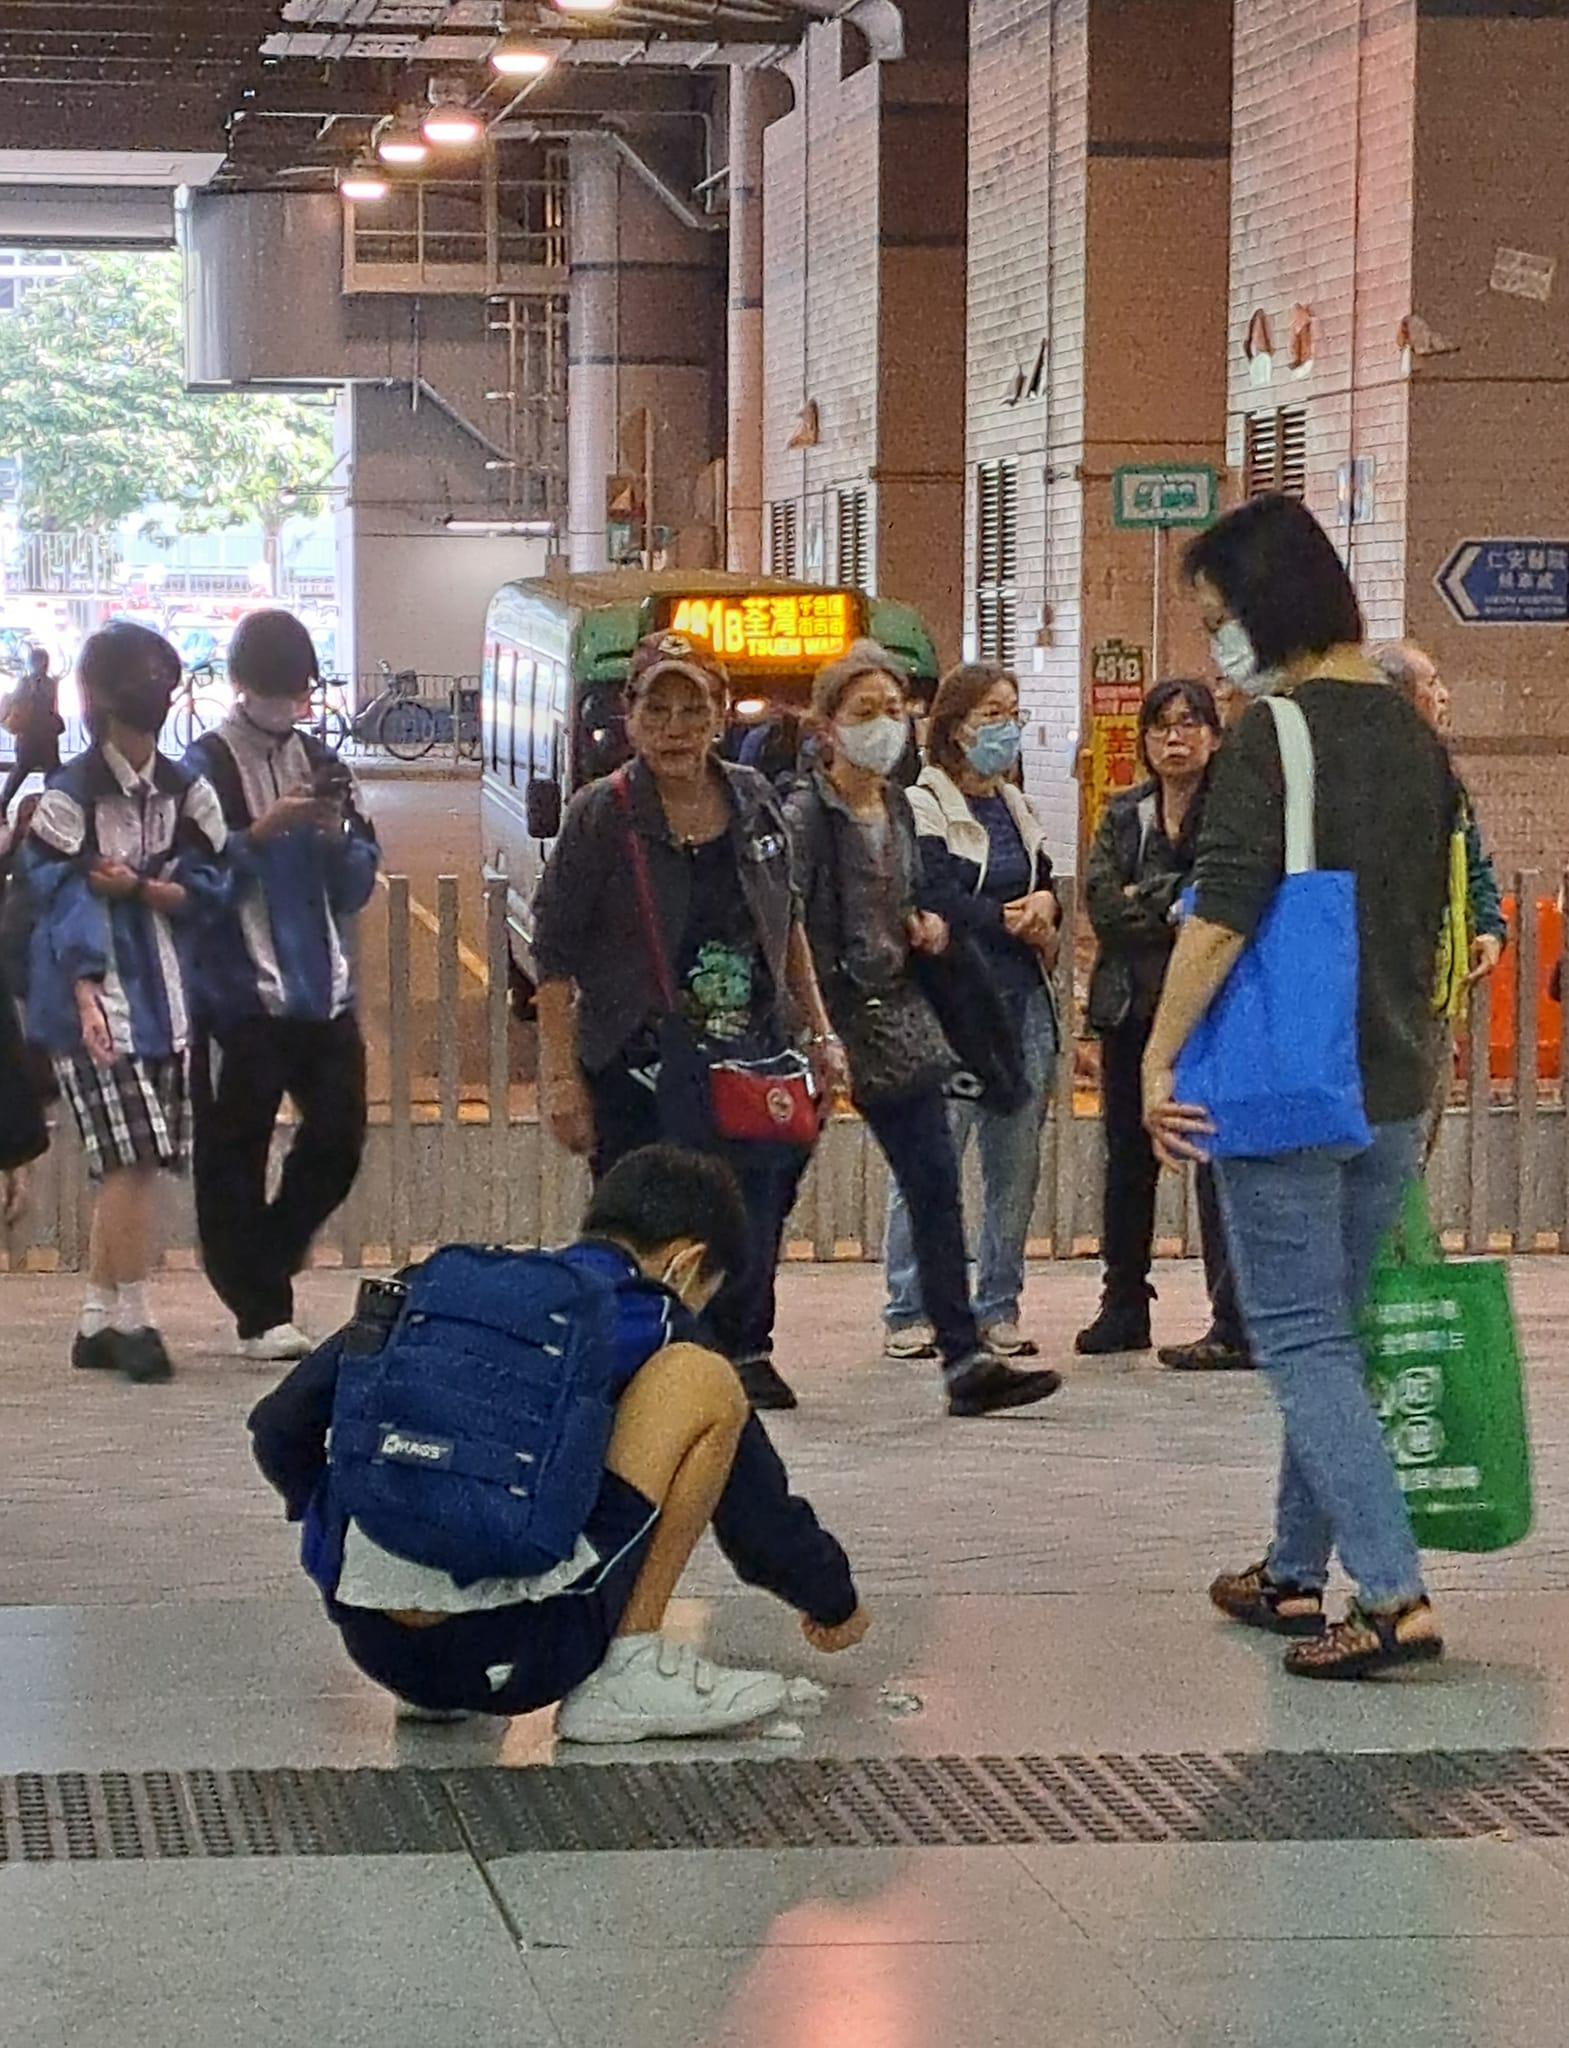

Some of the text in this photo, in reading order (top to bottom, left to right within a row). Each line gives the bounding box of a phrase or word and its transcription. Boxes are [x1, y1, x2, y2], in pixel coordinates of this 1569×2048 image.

[741, 597, 798, 637] 荃灣
[747, 637, 844, 656] TSUEN WAN
